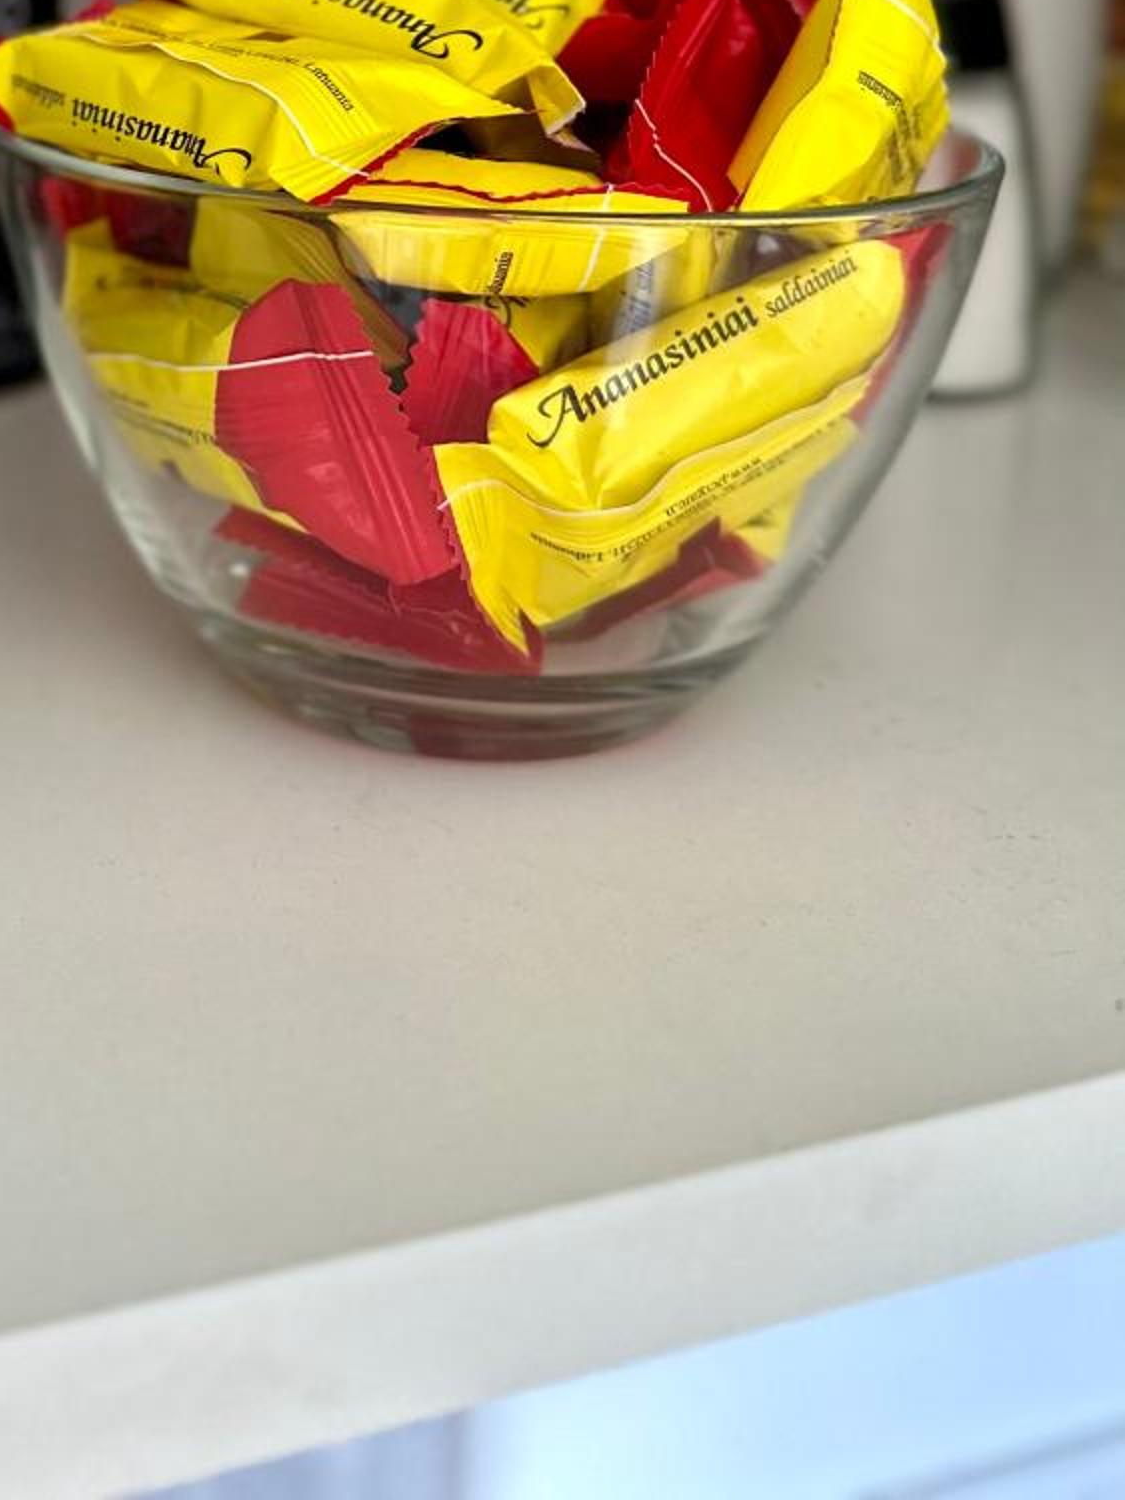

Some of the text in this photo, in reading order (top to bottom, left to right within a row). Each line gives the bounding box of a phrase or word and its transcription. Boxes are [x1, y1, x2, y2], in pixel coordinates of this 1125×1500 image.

[71, 97, 253, 175] Ananasiniai
[527, 296, 759, 448] Ananasiniai
[765, 250, 858, 319] saldainiai
